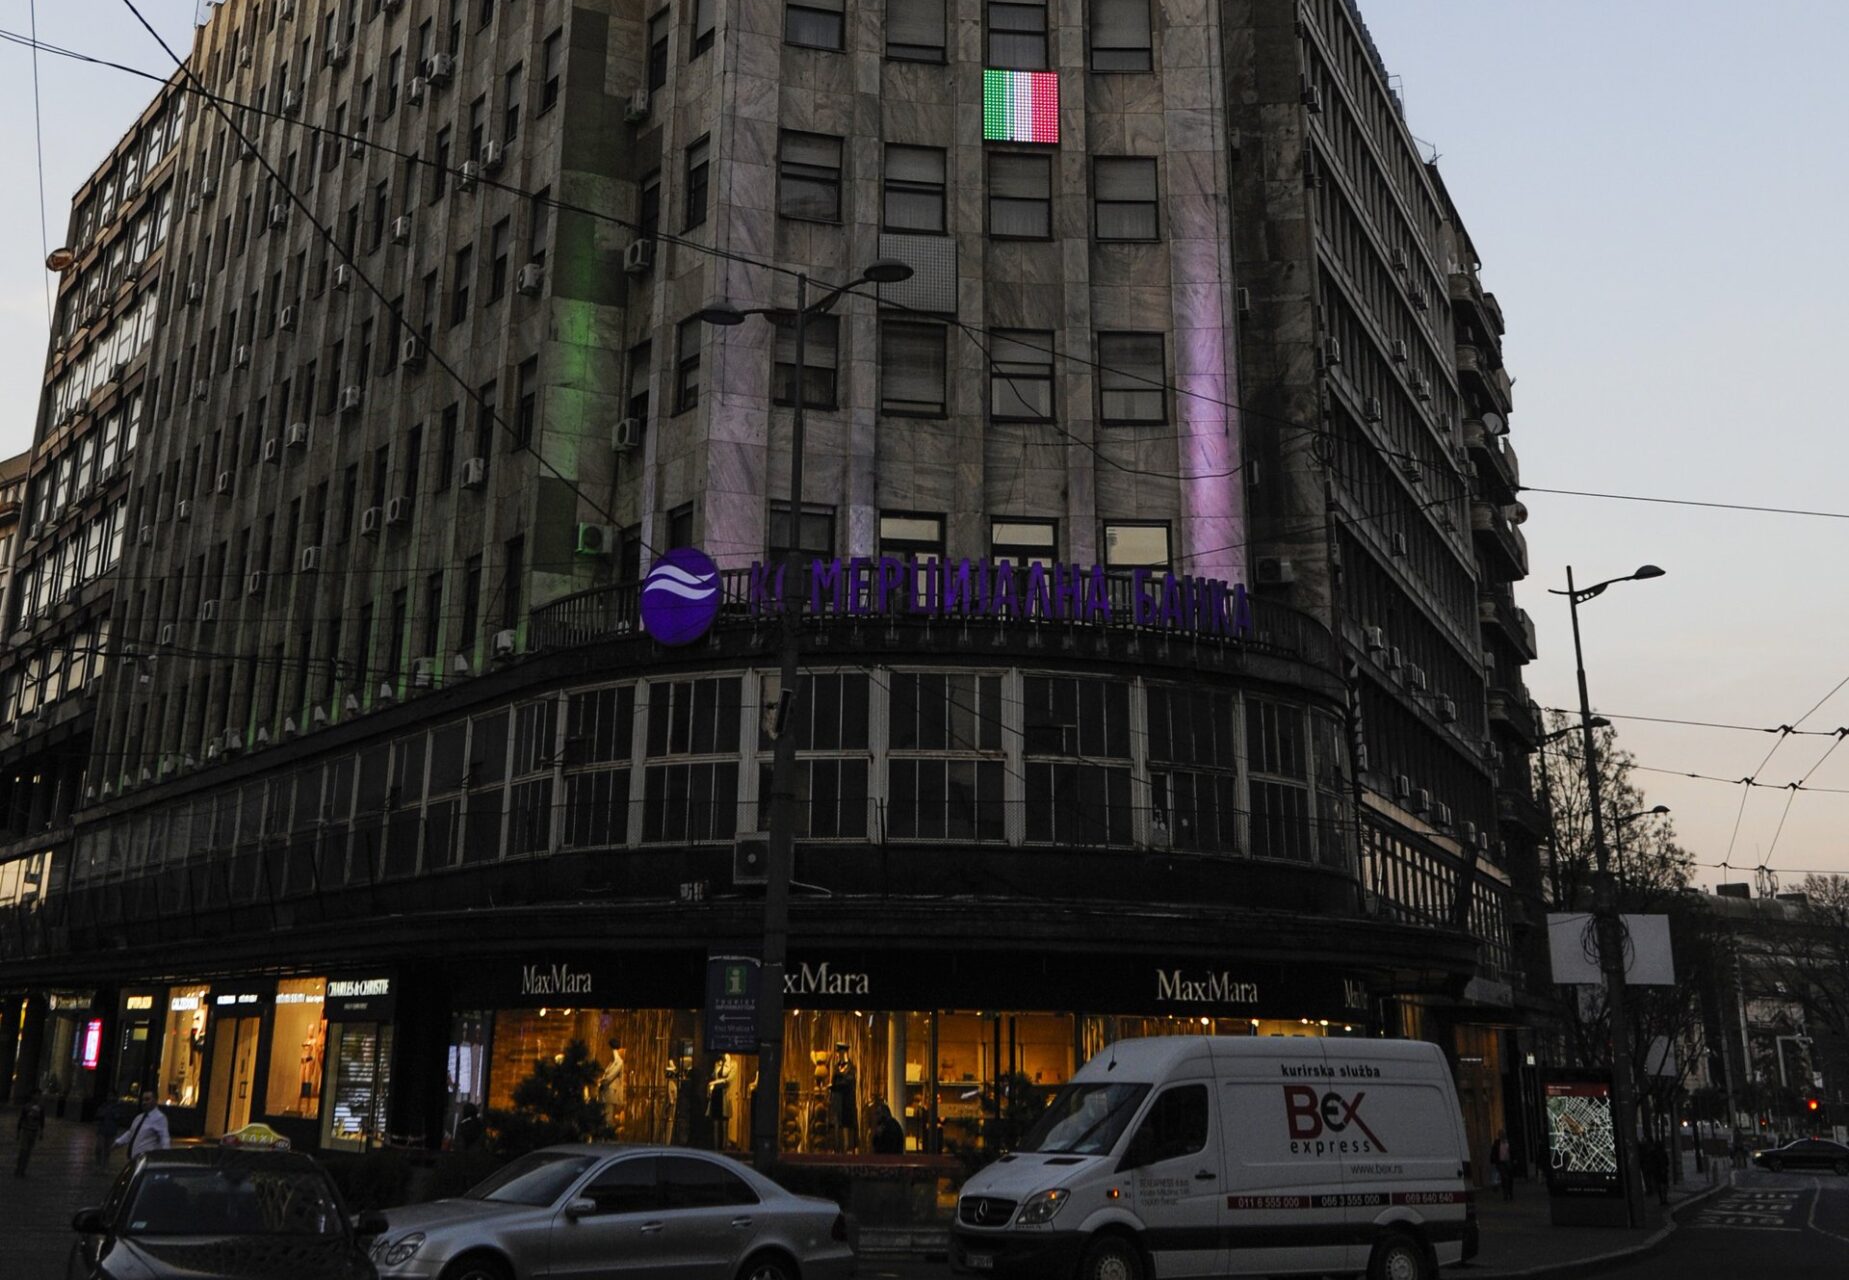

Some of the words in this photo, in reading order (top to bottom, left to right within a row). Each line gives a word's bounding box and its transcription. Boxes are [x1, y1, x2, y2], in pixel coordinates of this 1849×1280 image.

[1132, 566, 1253, 640] БАНКА
[521, 963, 593, 995] MaxMara
[783, 961, 871, 995] xMara
[1155, 968, 1259, 1004] MaxMara
[1281, 1064, 1335, 1078] kurirska
[1340, 1064, 1381, 1078] služba
[1290, 1140, 1371, 1157] express
[1238, 1197, 1254, 1209] 011
[1283, 1197, 1300, 1209] 000
[1364, 1194, 1380, 1205] 000
